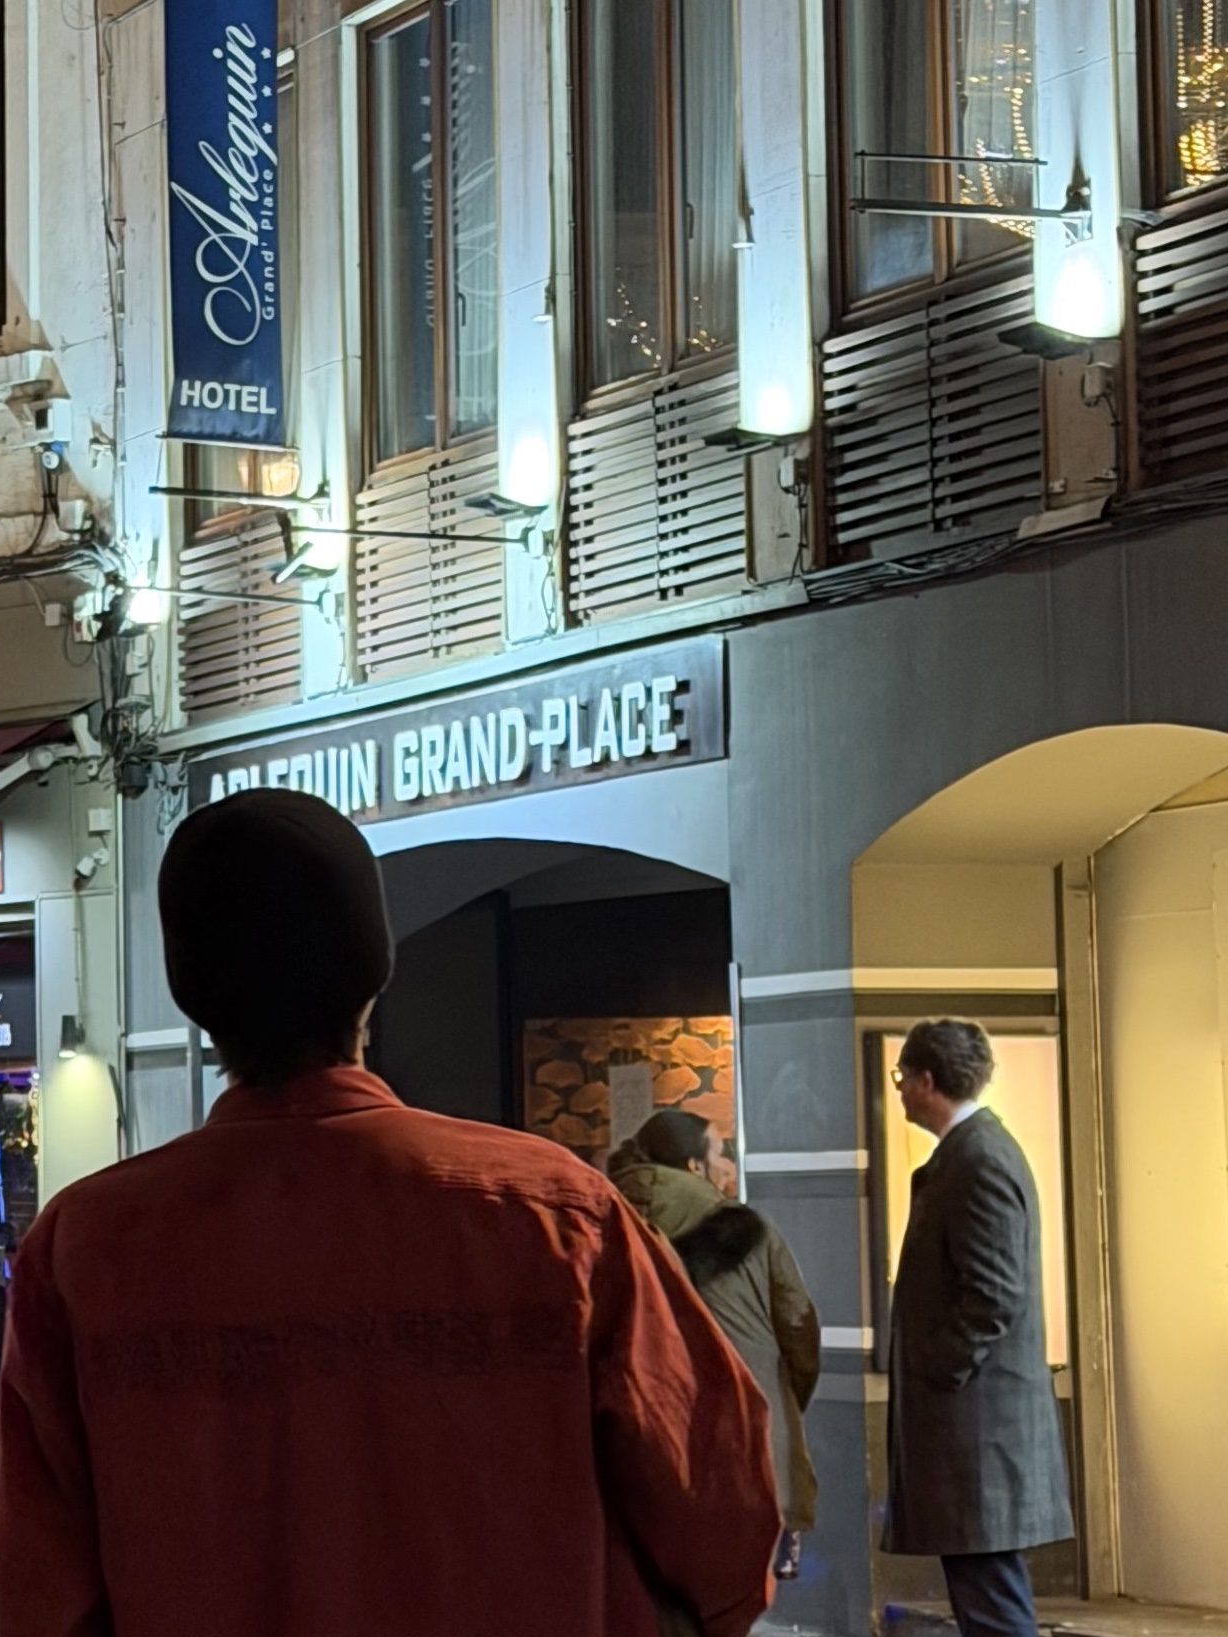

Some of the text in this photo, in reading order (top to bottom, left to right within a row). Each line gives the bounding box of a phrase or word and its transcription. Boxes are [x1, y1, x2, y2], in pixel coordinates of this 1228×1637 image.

[171, 22, 277, 346] Arlequin
[260, 169, 274, 231] Place
[180, 379, 277, 415] HOTEL
